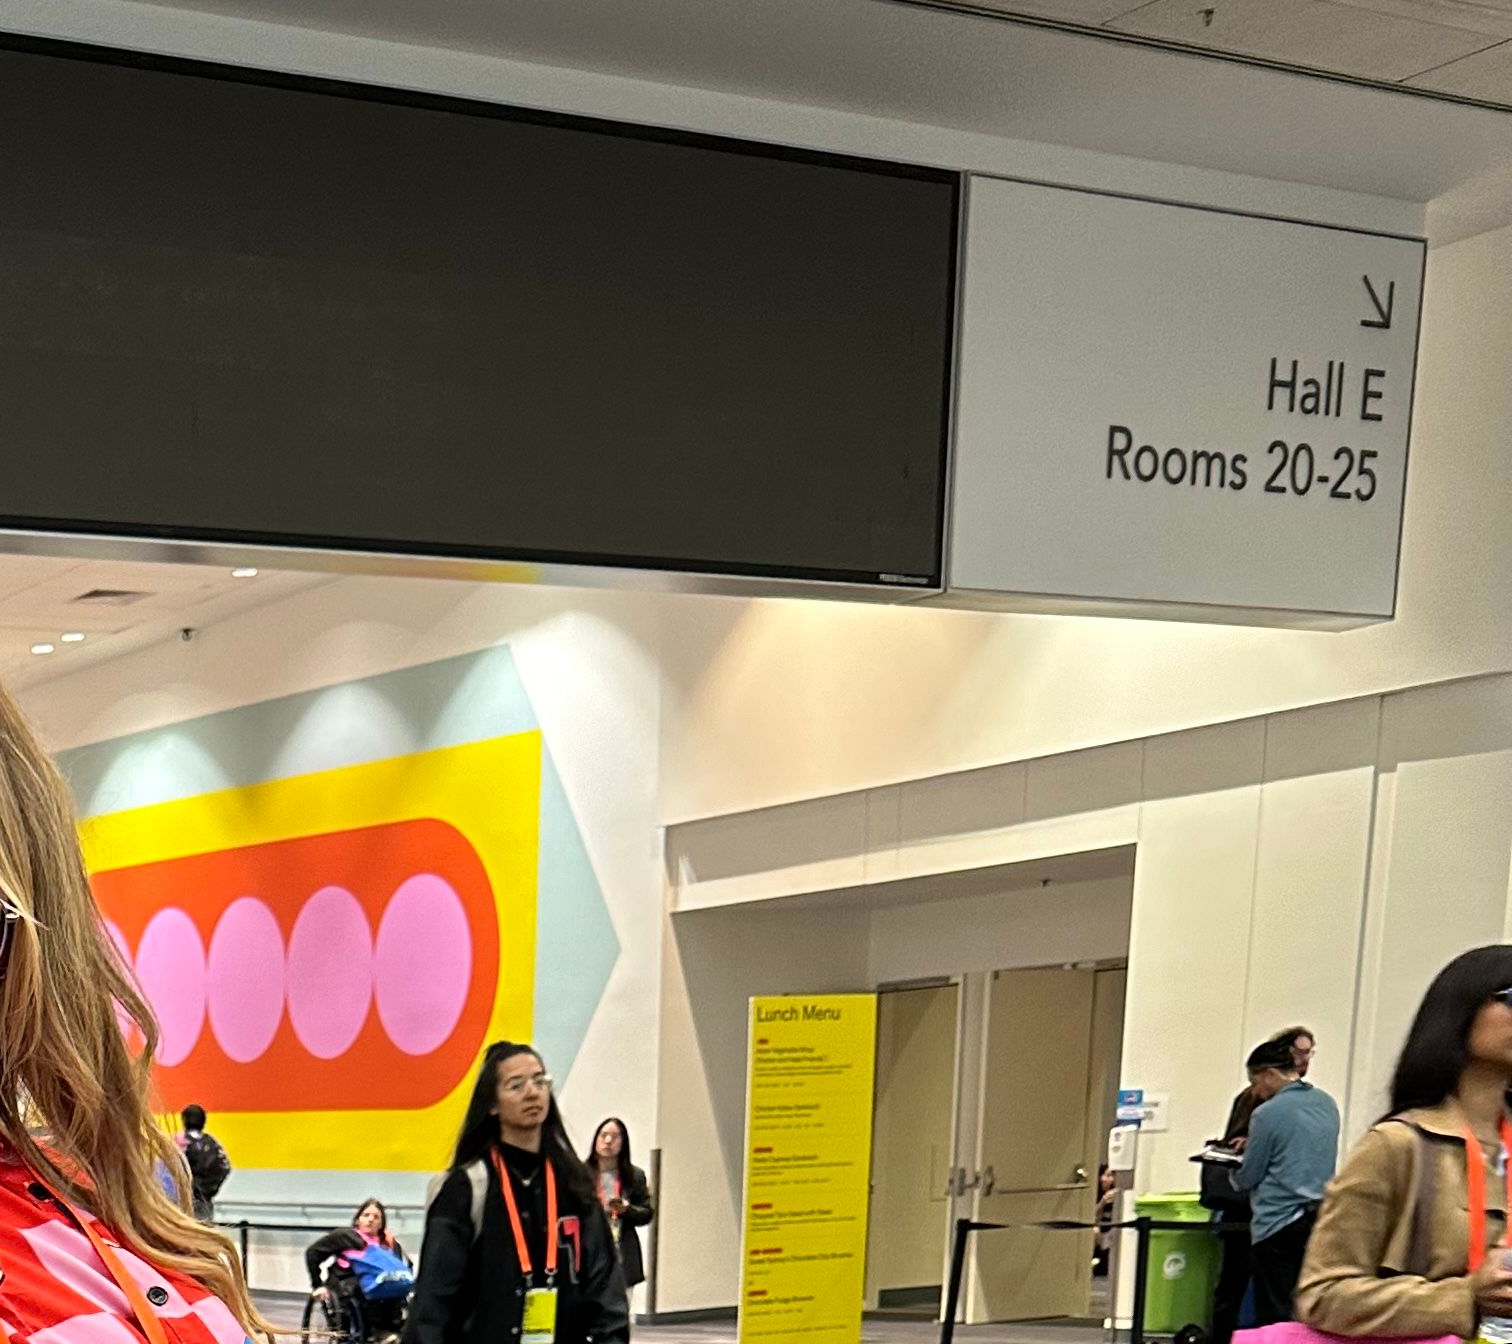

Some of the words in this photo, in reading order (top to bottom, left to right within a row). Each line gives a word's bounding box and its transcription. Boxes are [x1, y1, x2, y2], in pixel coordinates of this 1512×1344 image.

[1267, 357, 1345, 418] Hall
[1360, 368, 1386, 422] E
[1105, 424, 1249, 491] Rooms
[1263, 439, 1379, 502] 20-25
[756, 1006, 799, 1022] Lunch
[802, 1005, 842, 1021] Menu
